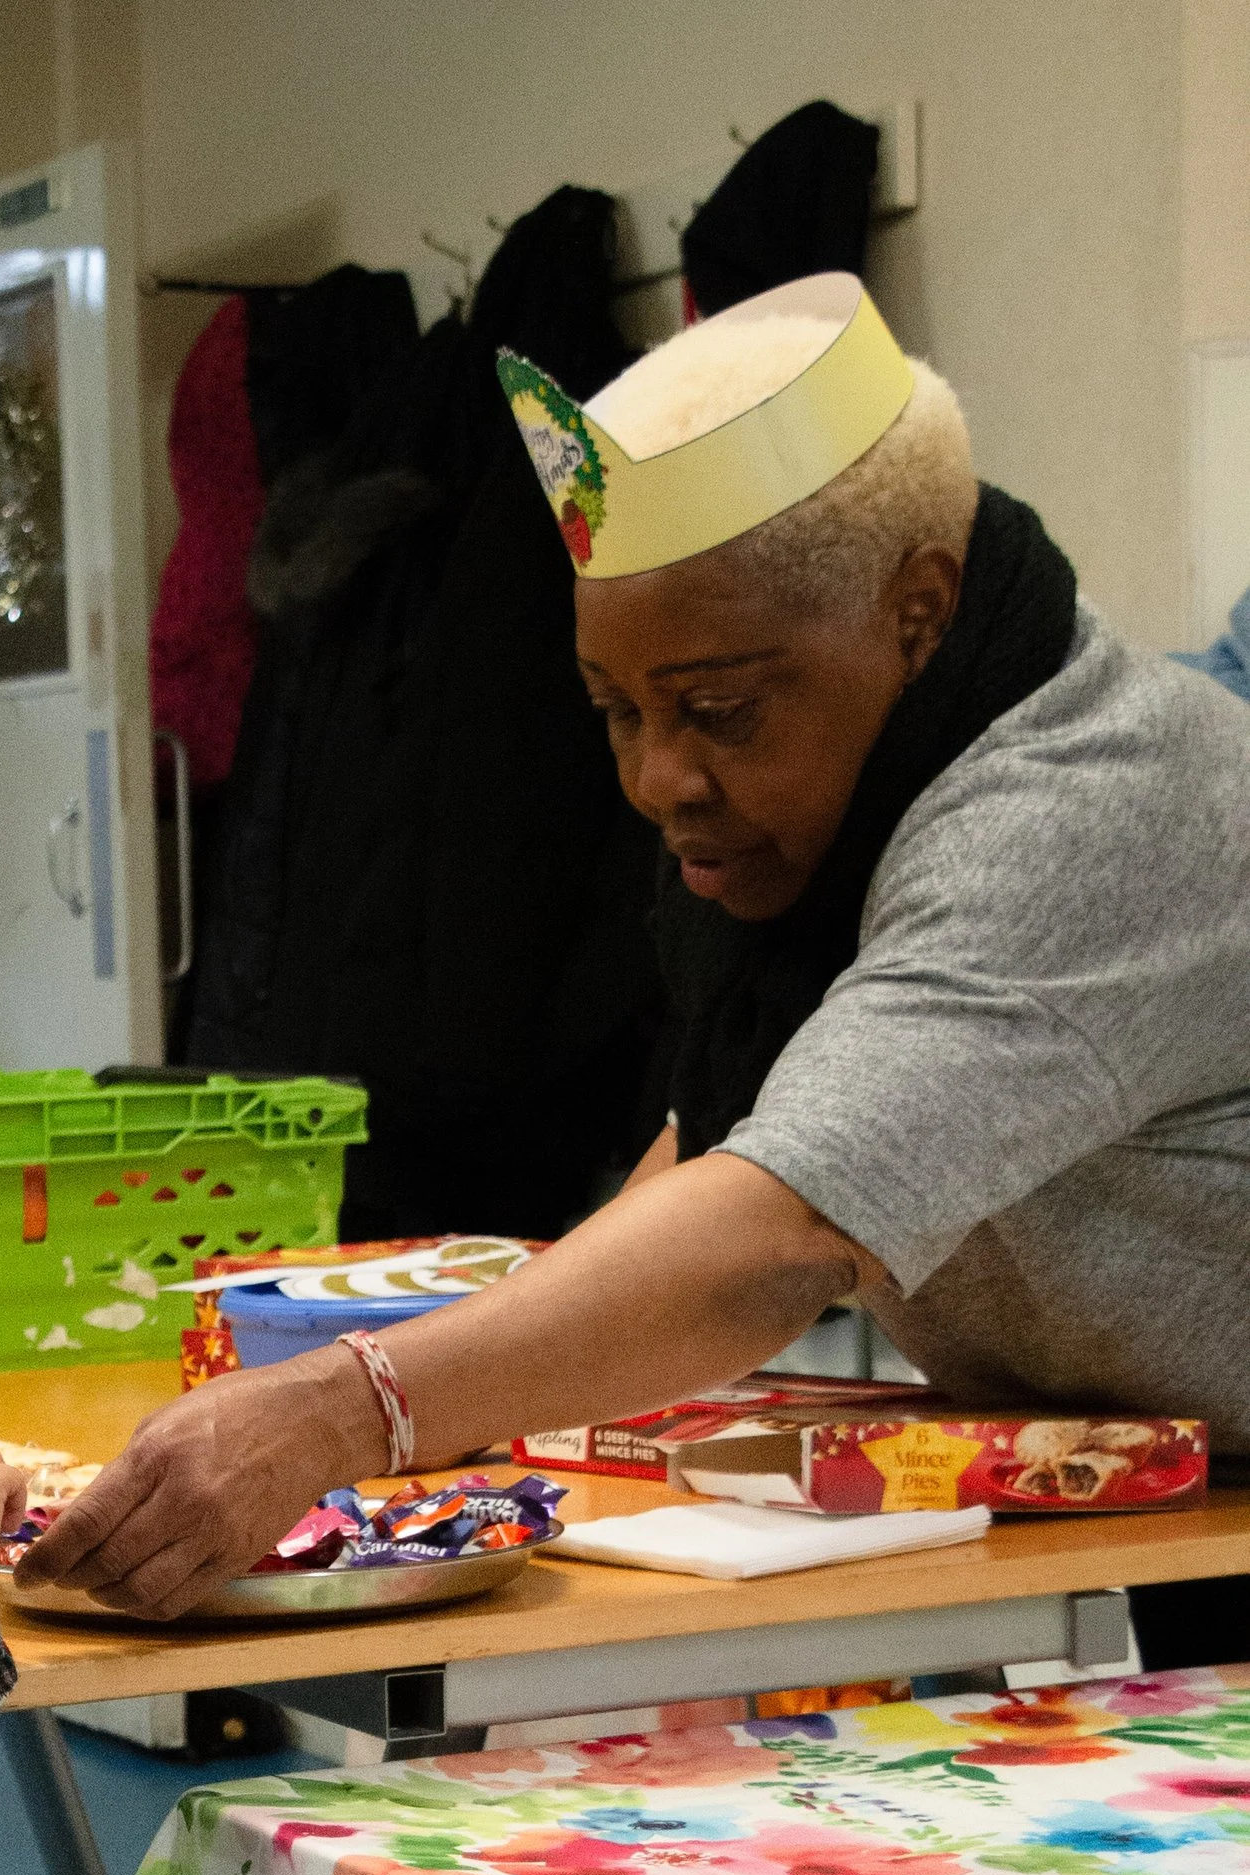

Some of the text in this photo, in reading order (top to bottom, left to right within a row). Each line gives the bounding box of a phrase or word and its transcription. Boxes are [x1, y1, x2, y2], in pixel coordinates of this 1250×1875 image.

[604, 1430, 633, 1445] DEEP
[916, 1428, 929, 1445] 6
[595, 1444, 657, 1463] MINCE PIES
[894, 1448, 952, 1469] Mince
[902, 1472, 941, 1491] Pies
